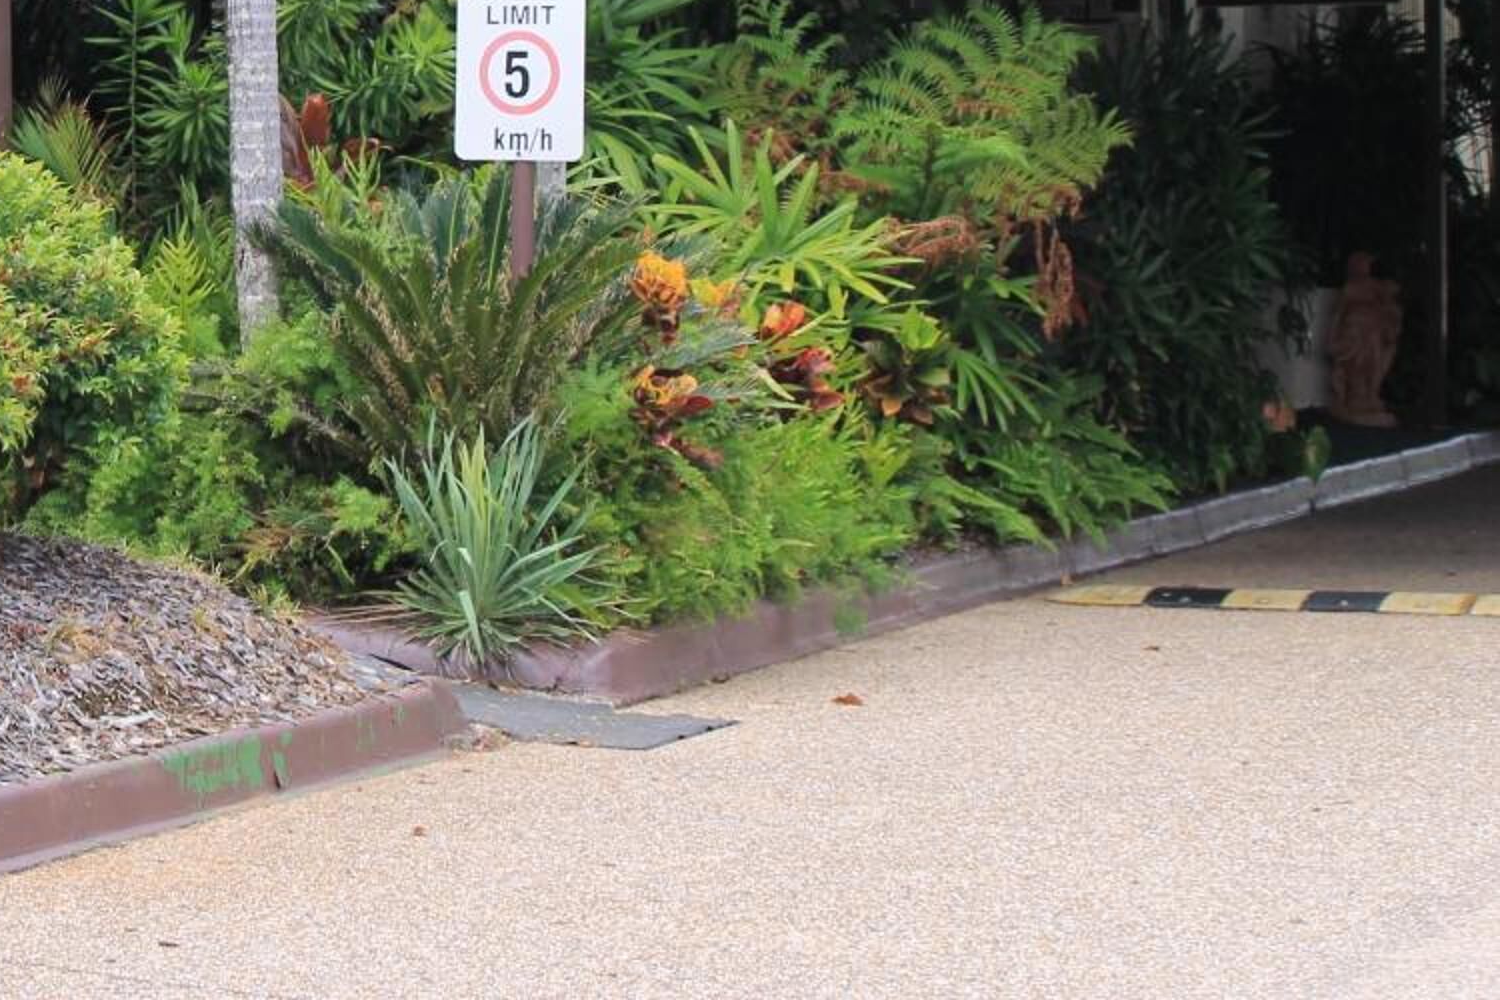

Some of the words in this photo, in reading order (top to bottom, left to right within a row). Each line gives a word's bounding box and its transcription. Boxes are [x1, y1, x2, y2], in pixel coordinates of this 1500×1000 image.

[486, 5, 555, 25] LIMIT
[504, 51, 530, 98] 5
[494, 127, 553, 152] km/h
